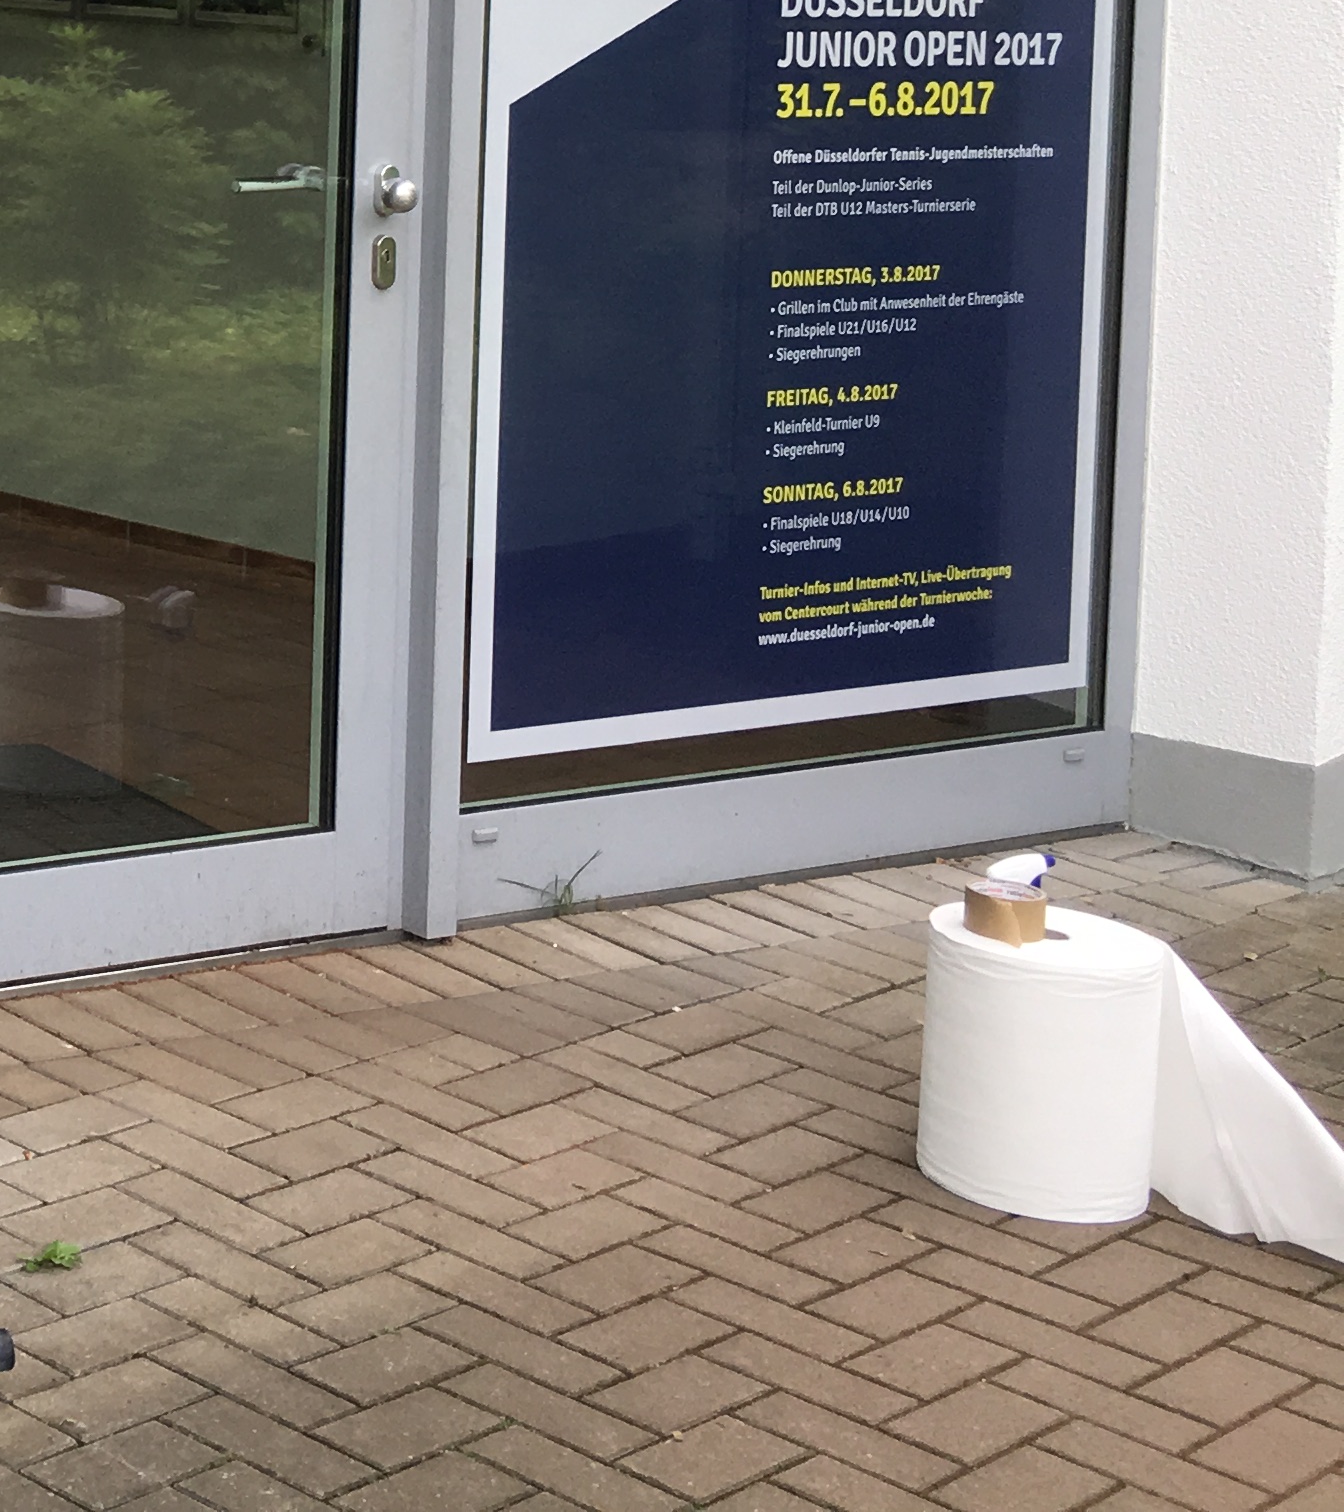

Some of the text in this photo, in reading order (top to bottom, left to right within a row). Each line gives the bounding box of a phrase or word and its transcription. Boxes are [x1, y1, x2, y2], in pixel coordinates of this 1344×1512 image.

[776, 30, 1063, 68] JUNIOR OPEN 2017
[773, 144, 1054, 165] Offene Düsseldorfer Tennis-Jugendmeisterschaften
[772, 177, 933, 196] Teil der Dunlop-Junior-Series
[772, 197, 976, 218] Teil der DTB U12 Masters-Turnierserie
[771, 264, 941, 288] DONNERSTAG, 3.8.2017
[778, 290, 1025, 316] Grillen im Club mit Anwesenheit der Ehrengäste
[777, 318, 917, 340] Finalspiele U21/U16/U12
[776, 345, 861, 364] Siegerehrungen
[766, 383, 898, 408] FREITAG, 4.8.2017
[773, 414, 881, 435] Kleinfeld-Turnier U9
[773, 440, 845, 460] Siegerehrung
[763, 476, 904, 504] SONNTAG, 6.8.2017
[770, 506, 910, 531] Finalspiele U18/U14/U10
[769, 536, 842, 555] Siegerehrung
[760, 563, 1012, 600] Turnier-Infos und Internet-TV, Live-Übertragung
[759, 587, 993, 622] vom Centercourt während der Turnierwoche:
[758, 614, 935, 646] www.duesseldorf-junior-open.de
